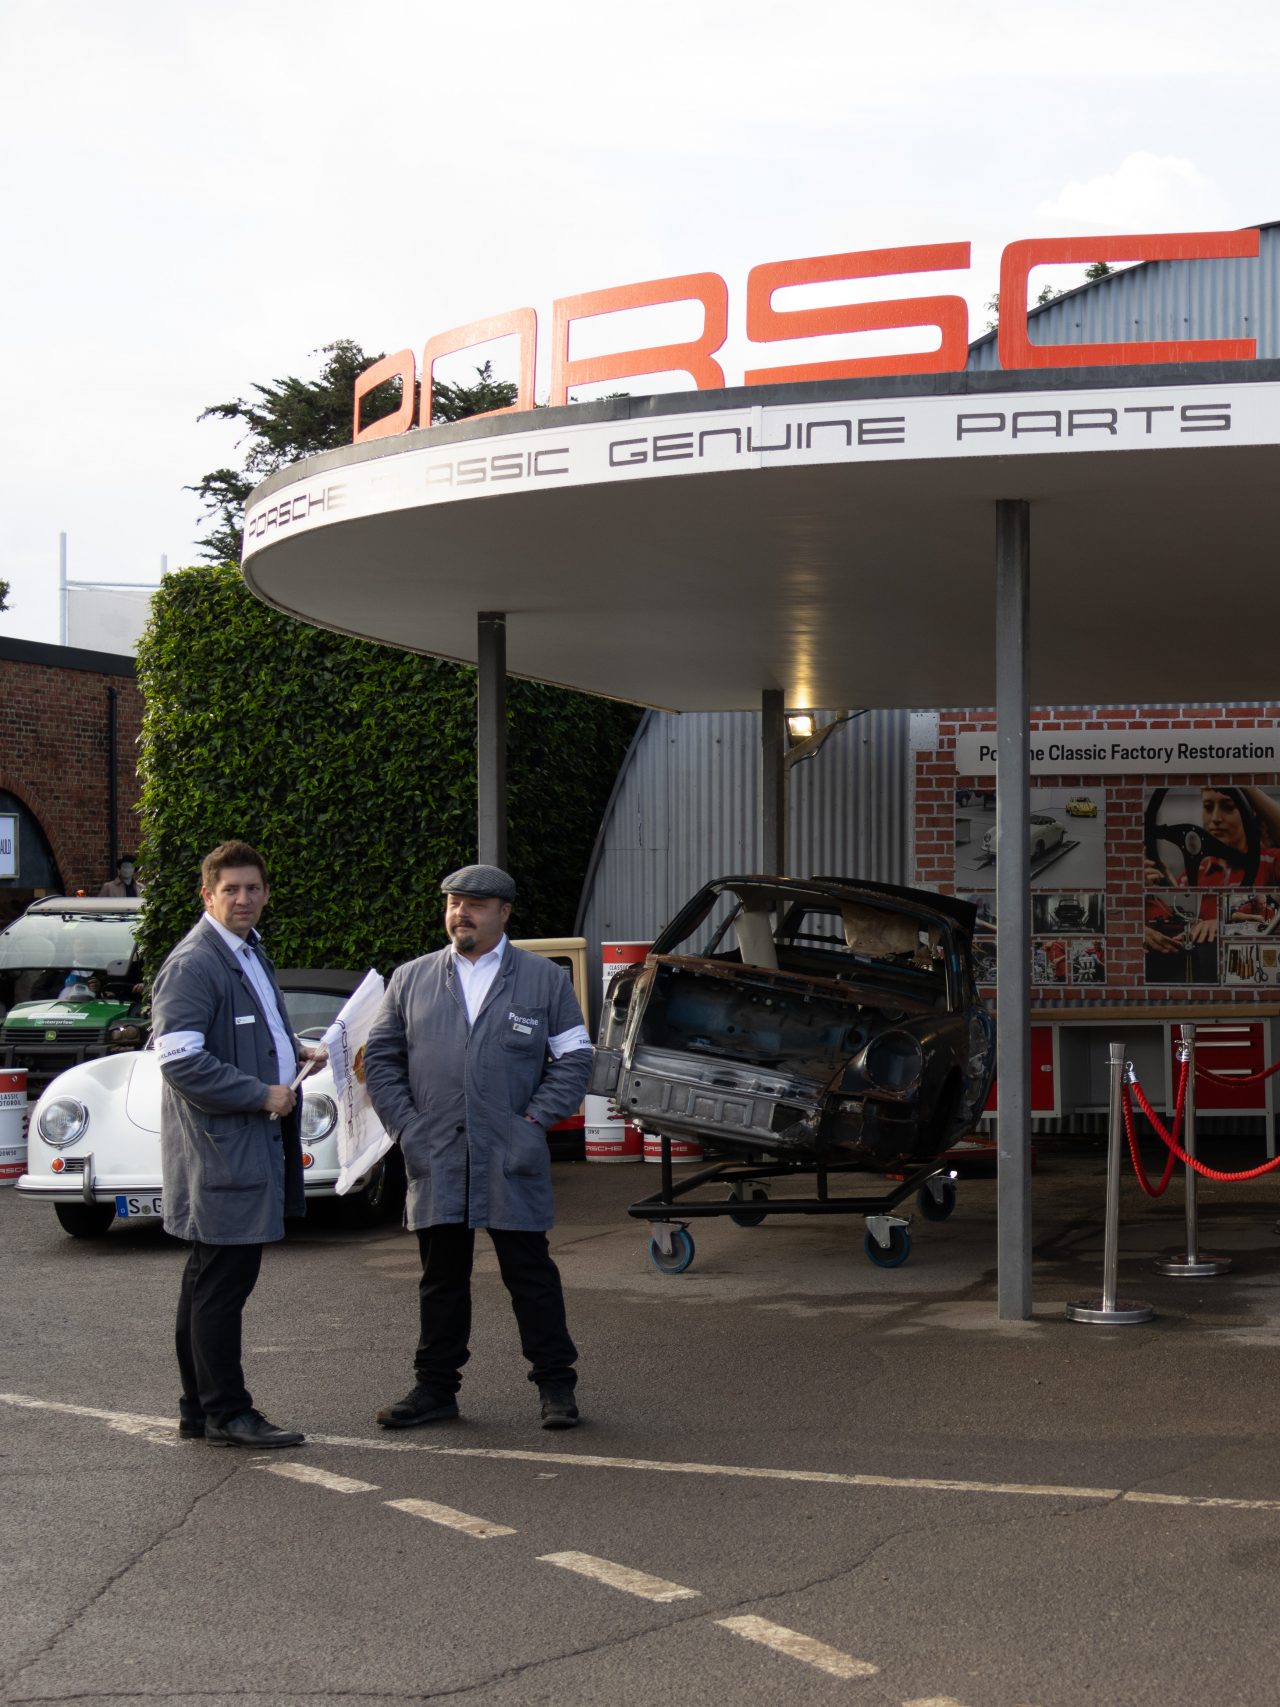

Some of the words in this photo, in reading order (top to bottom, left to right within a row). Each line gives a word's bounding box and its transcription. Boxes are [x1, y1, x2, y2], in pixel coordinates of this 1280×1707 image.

[248, 483, 348, 538] PORSCHE
[607, 416, 906, 468] GENUINE
[955, 403, 1232, 442] PARTS
[1048, 743, 1107, 762] Classic
[1110, 742, 1174, 764] Factory
[1177, 742, 1275, 761] Restoration
[508, 1011, 539, 1026] Porsche
[128, 1198, 141, 1214] S
